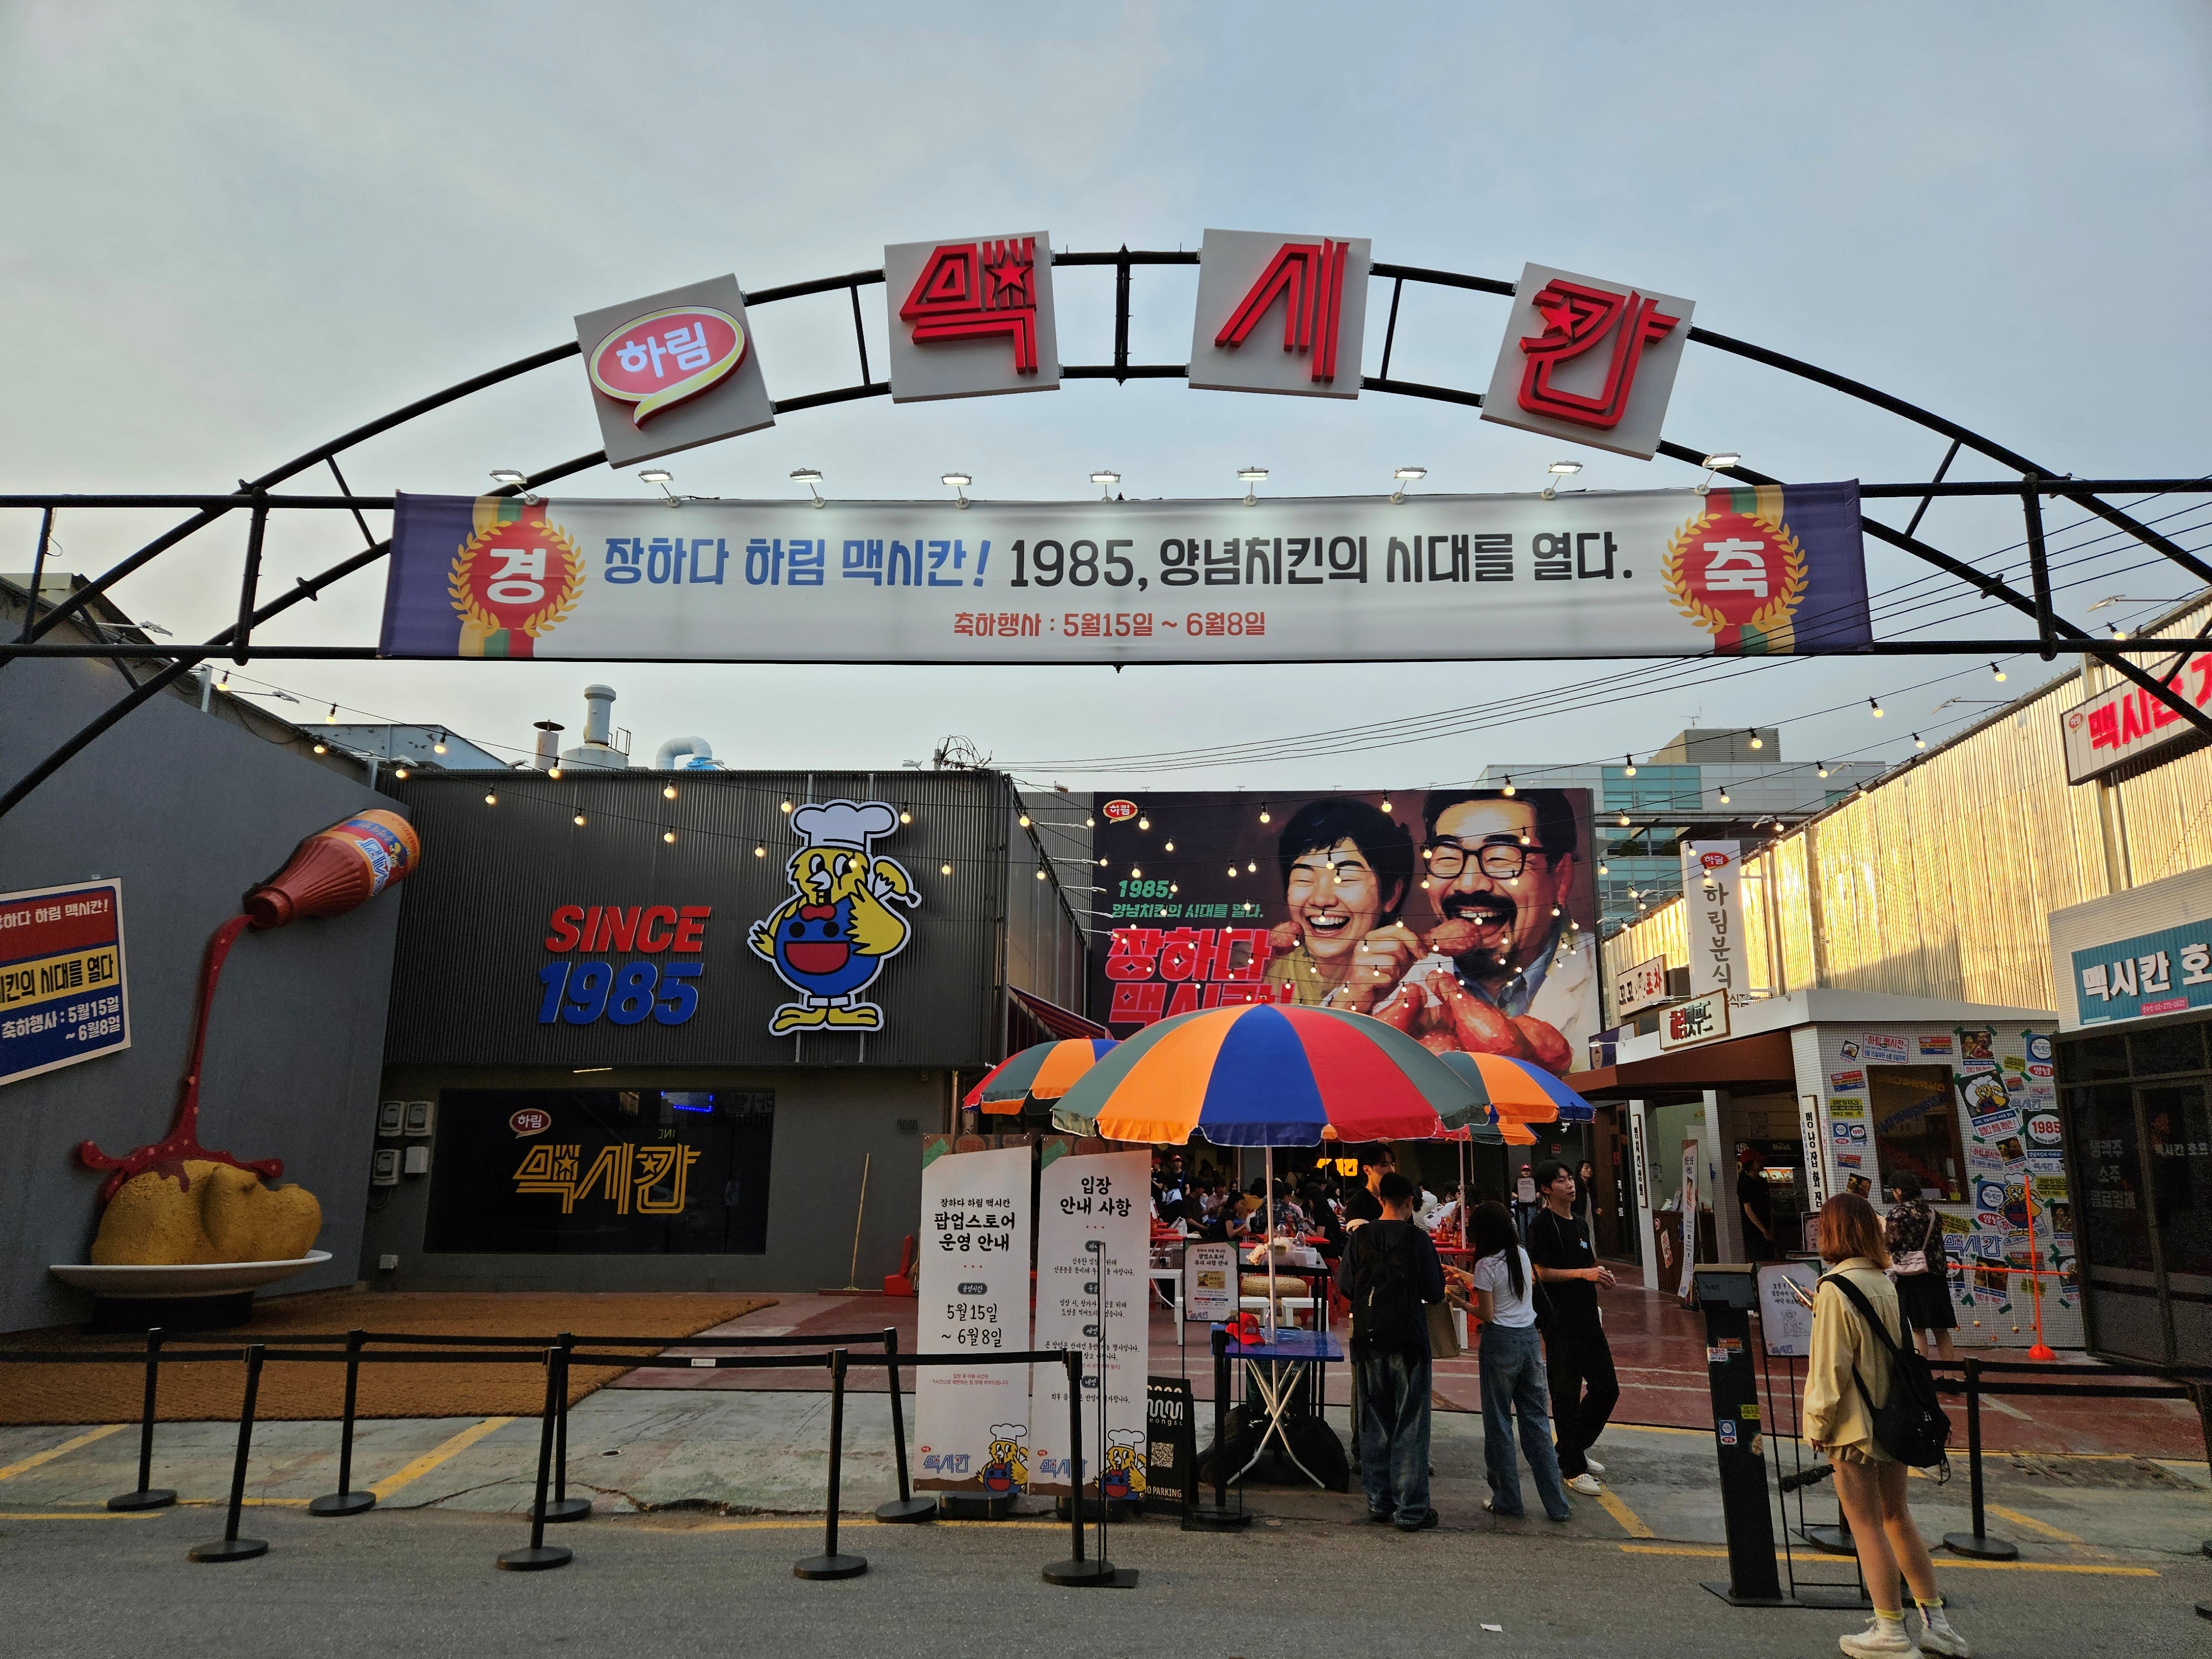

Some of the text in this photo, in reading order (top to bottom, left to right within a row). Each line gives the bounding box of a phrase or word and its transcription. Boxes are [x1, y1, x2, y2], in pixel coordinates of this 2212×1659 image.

[615, 320, 712, 379] 하림
[604, 531, 1632, 592] 장하다 하림 맥시칸! 1985, 양념치킨의 시대를 열다.
[1704, 537, 1767, 598] 축
[487, 547, 546, 604] 경
[954, 612, 1041, 637] 축하행사
[1063, 612, 1153, 637] 5월15일
[1186, 612, 1266, 637] 6월8일
[1109, 804, 1130, 816] 하림
[1704, 855, 1724, 864] 하림
[1118, 880, 1174, 899] 1985,
[35, 906, 61, 924] 하림
[65, 899, 108, 917] 맥시칸!
[1112, 903, 1181, 918] 양념치킨의
[1185, 904, 1228, 918] 시대를
[545, 905, 711, 953] SINCE
[1703, 882, 1731, 989] 하림분식
[1106, 927, 1274, 982] 장하다
[41, 959, 83, 994] 시대를
[87, 953, 113, 984] 열다
[2082, 943, 2212, 1001] 맥시칸 호
[538, 961, 704, 1025] 1985
[2, 1012, 57, 1039] 축하행사
[68, 995, 119, 1023] 5월15일
[79, 1015, 121, 1041] 6월8일
[1868, 1035, 1882, 1045] 하림
[517, 1114, 542, 1129] 하림
[2032, 1121, 2061, 1134] 1985
[512, 1142, 701, 1215] 맥시칸
[1081, 1176, 1112, 1195] 입장
[940, 1198, 1011, 1208] 장하다 하림 맥시칸
[1060, 1196, 1132, 1217] 안내 사항
[934, 1211, 1015, 1230] 팝업스토어
[939, 1233, 1009, 1252] 운영 안내
[1944, 1234, 2002, 1257] 맥시칸
[1149, 1417, 1184, 1427] eongs
[923, 1453, 971, 1474] 맥시칸
[1040, 1458, 1088, 1478] 맥시
[1152, 1486, 1182, 1498] PARKING
